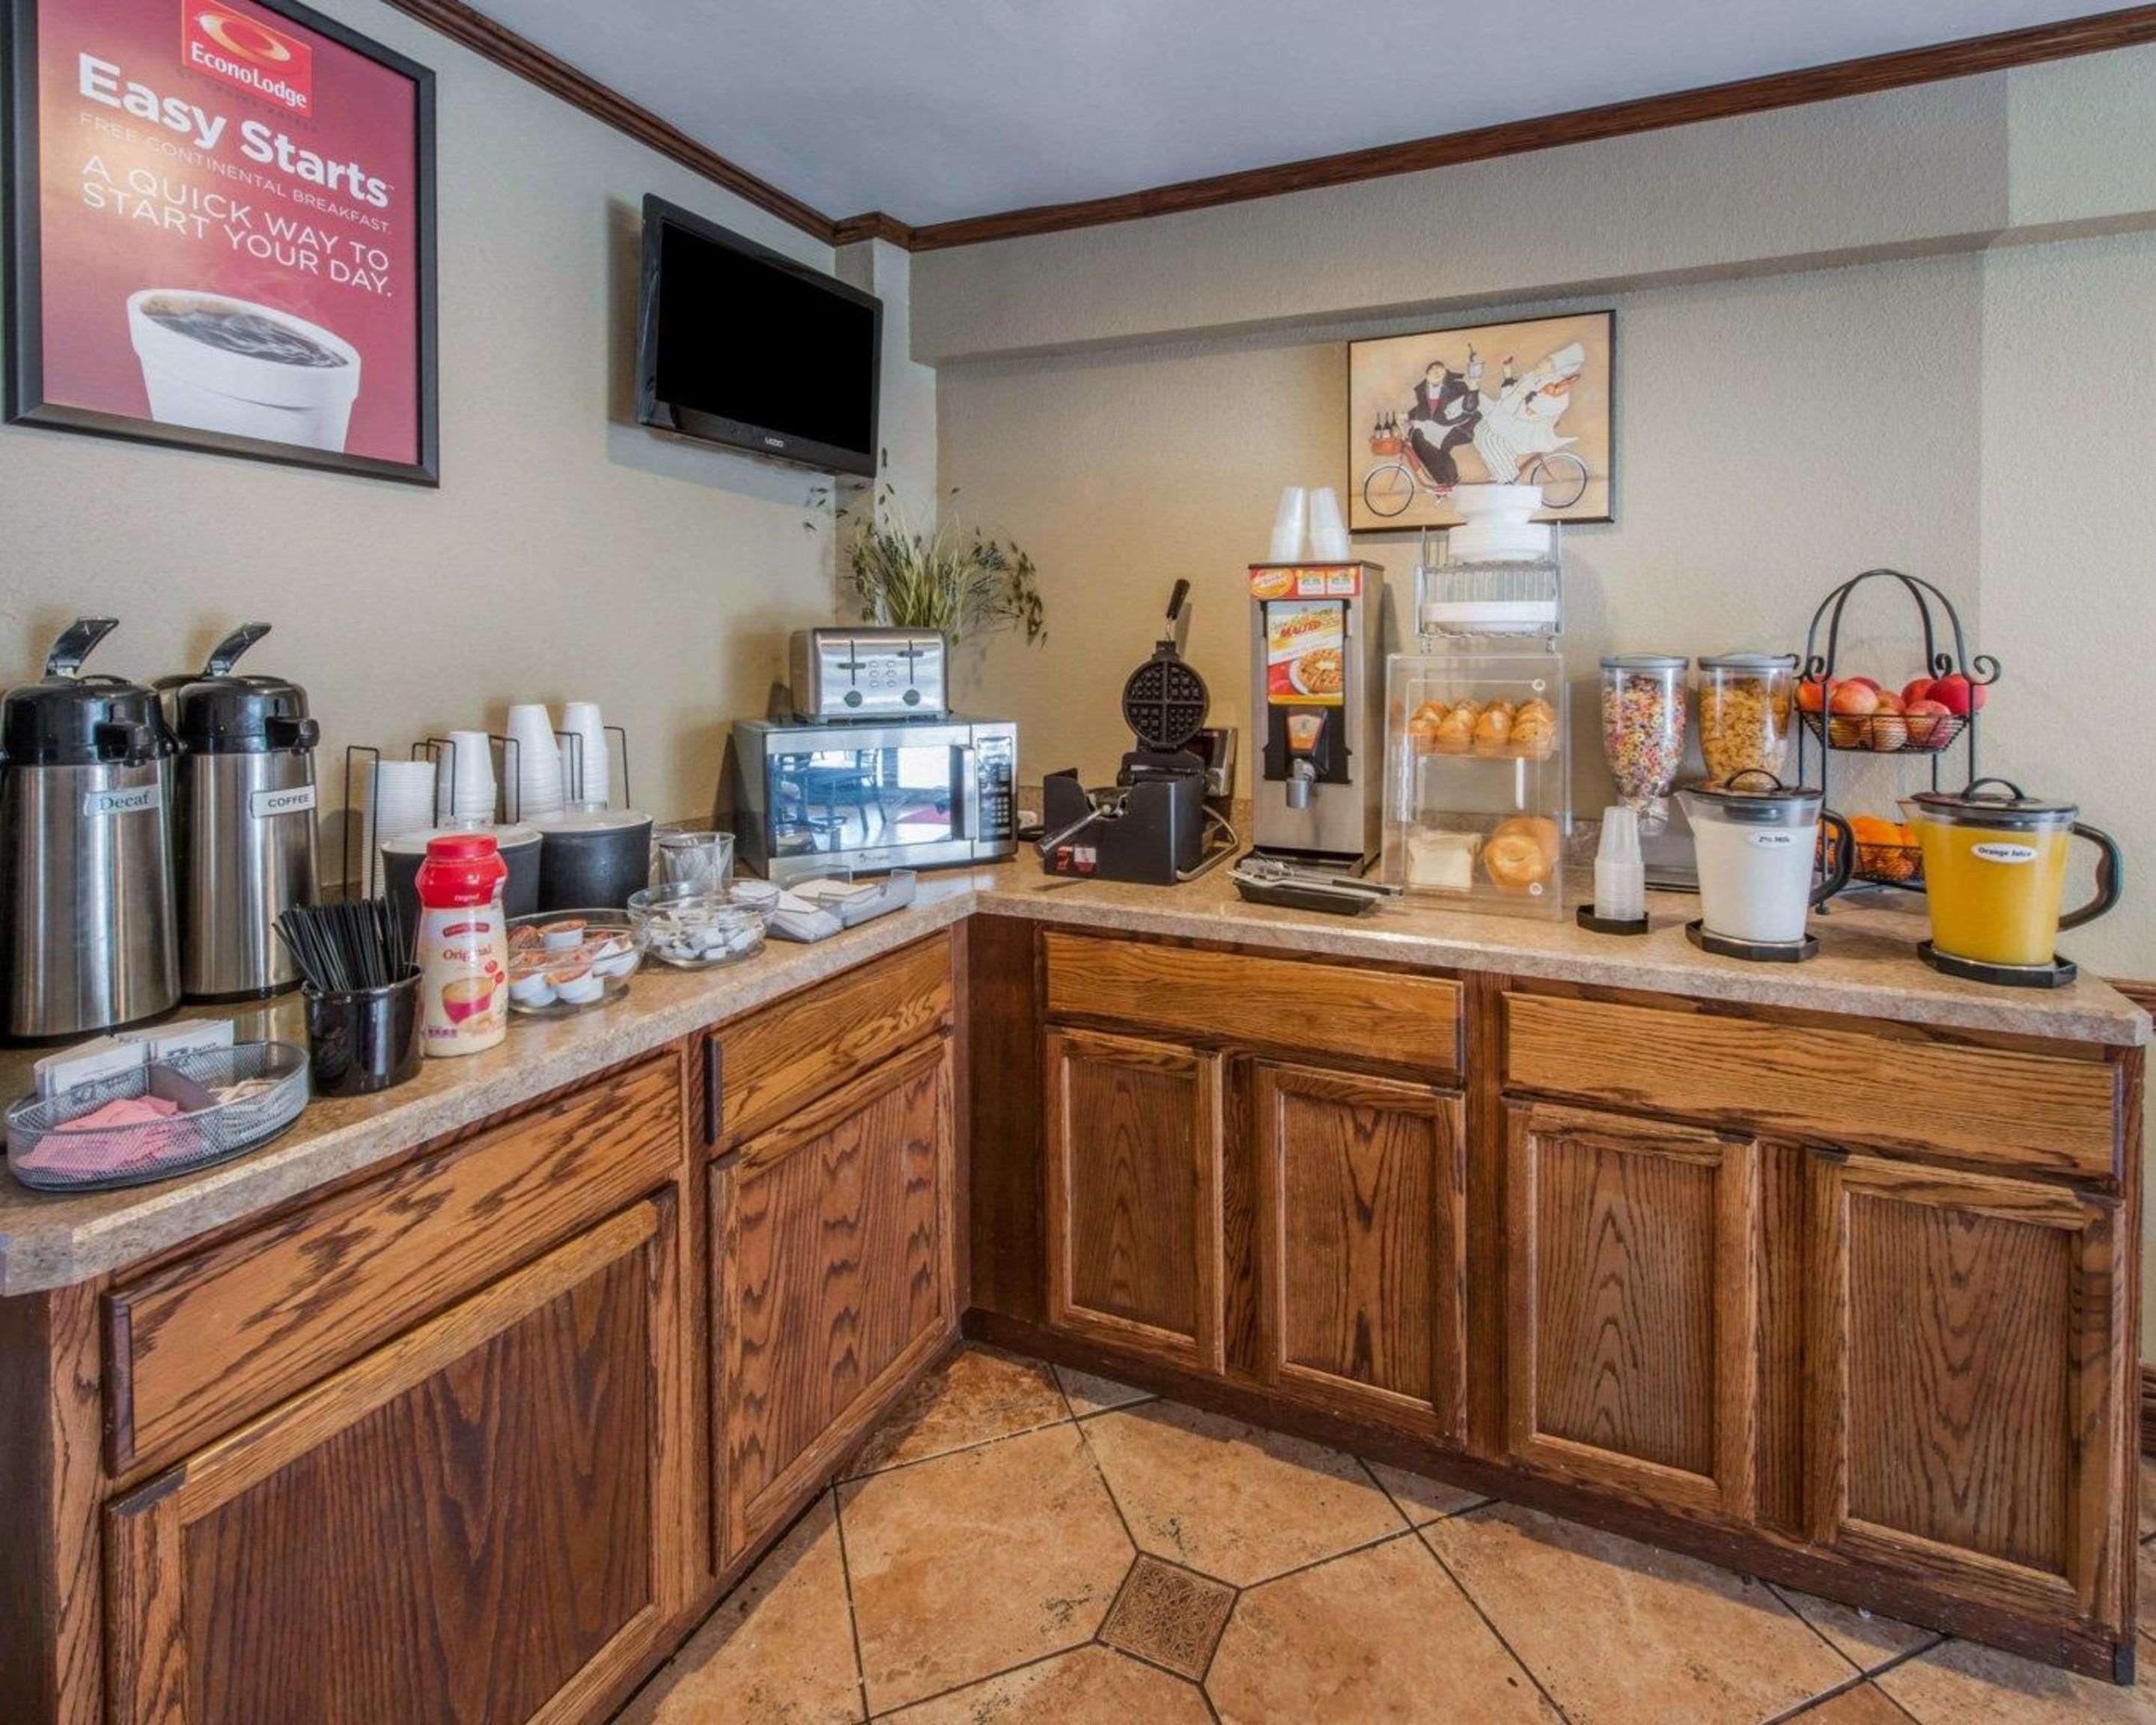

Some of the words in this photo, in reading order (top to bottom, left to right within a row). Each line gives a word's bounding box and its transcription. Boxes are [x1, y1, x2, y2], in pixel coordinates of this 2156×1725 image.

[79, 52, 227, 150] Easy
[240, 120, 389, 208] Starts
[80, 112, 138, 144] FREE
[147, 136, 287, 198] CONTINENTAL
[82, 154, 113, 185] A
[129, 168, 252, 229] QUICK
[264, 211, 339, 255] WAY
[349, 240, 389, 271] TO
[82, 181, 210, 239] START
[224, 224, 319, 276] YOUR
[330, 259, 392, 298] DAY.
[99, 791, 150, 810] Decaf
[267, 793, 311, 809] COFFEE
[1978, 847, 2008, 857] Orange
[2011, 849, 2032, 857] Juice
[442, 943, 492, 963] Orignal
